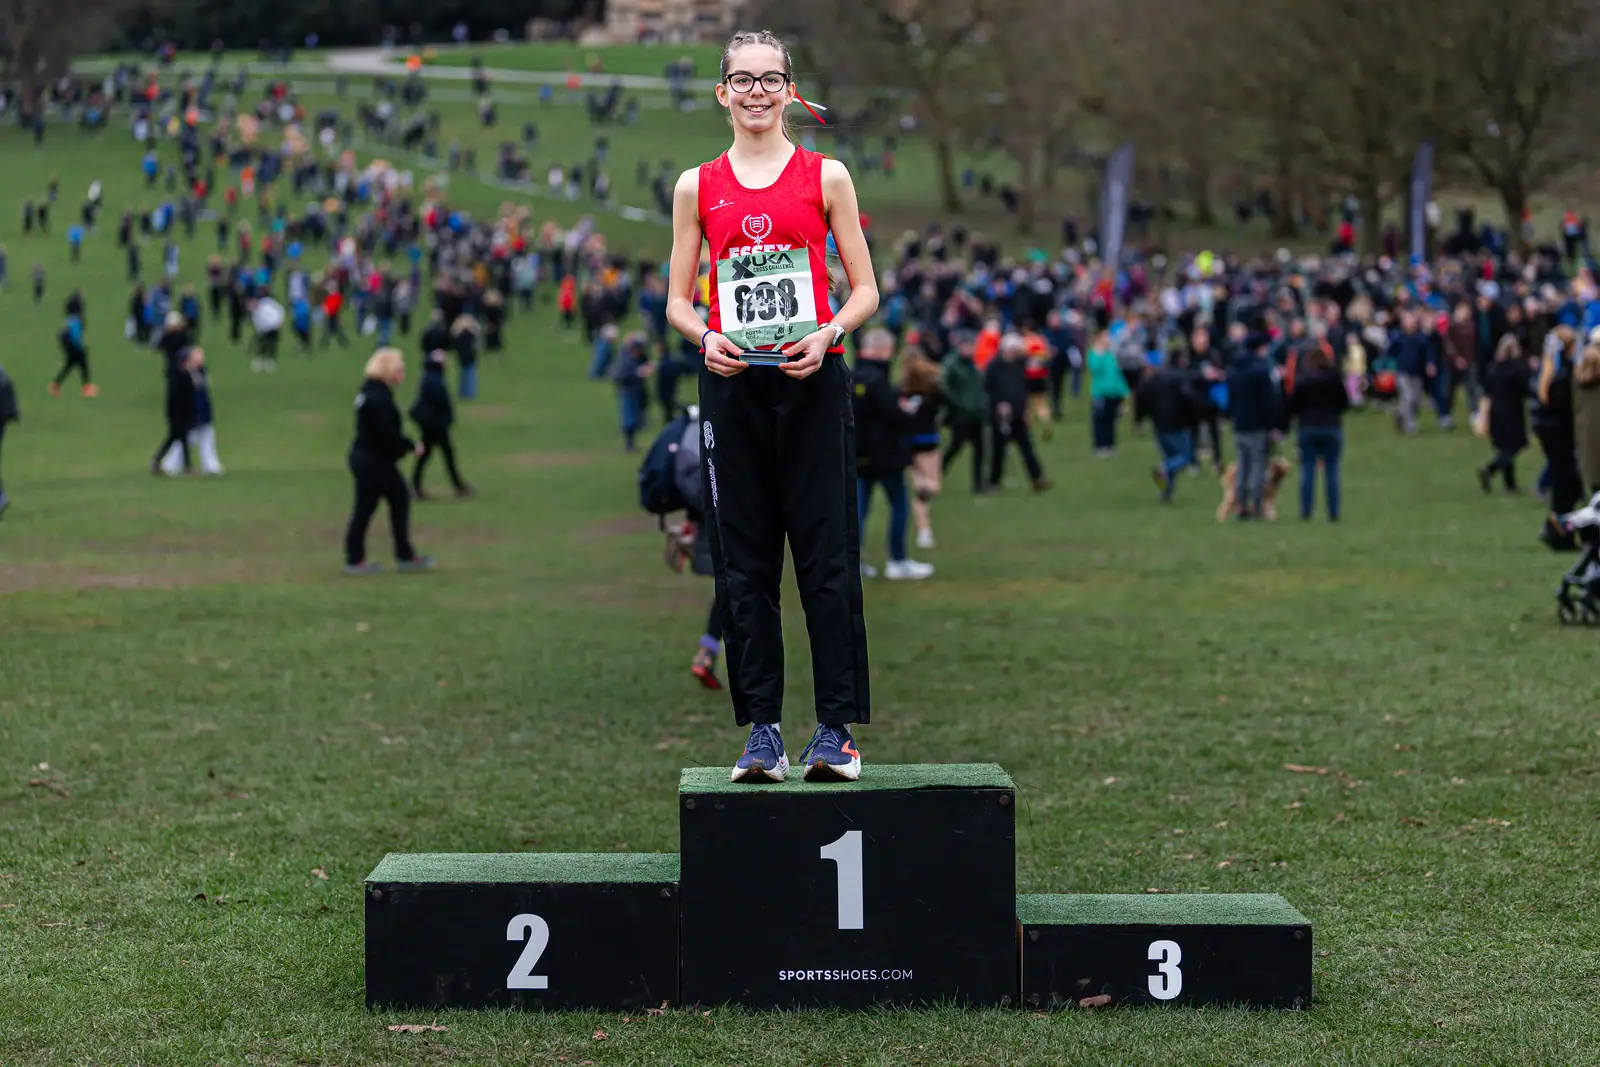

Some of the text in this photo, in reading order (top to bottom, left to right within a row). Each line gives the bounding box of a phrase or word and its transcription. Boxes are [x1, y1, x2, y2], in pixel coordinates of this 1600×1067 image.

[729, 244, 792, 258] ESSEX
[753, 262, 795, 273] CROSS CHALLENGE
[820, 830, 864, 930] 1
[506, 913, 550, 990] 2
[1147, 939, 1183, 1000] 3
[779, 969, 913, 981] SPORTSSHOES.COM
